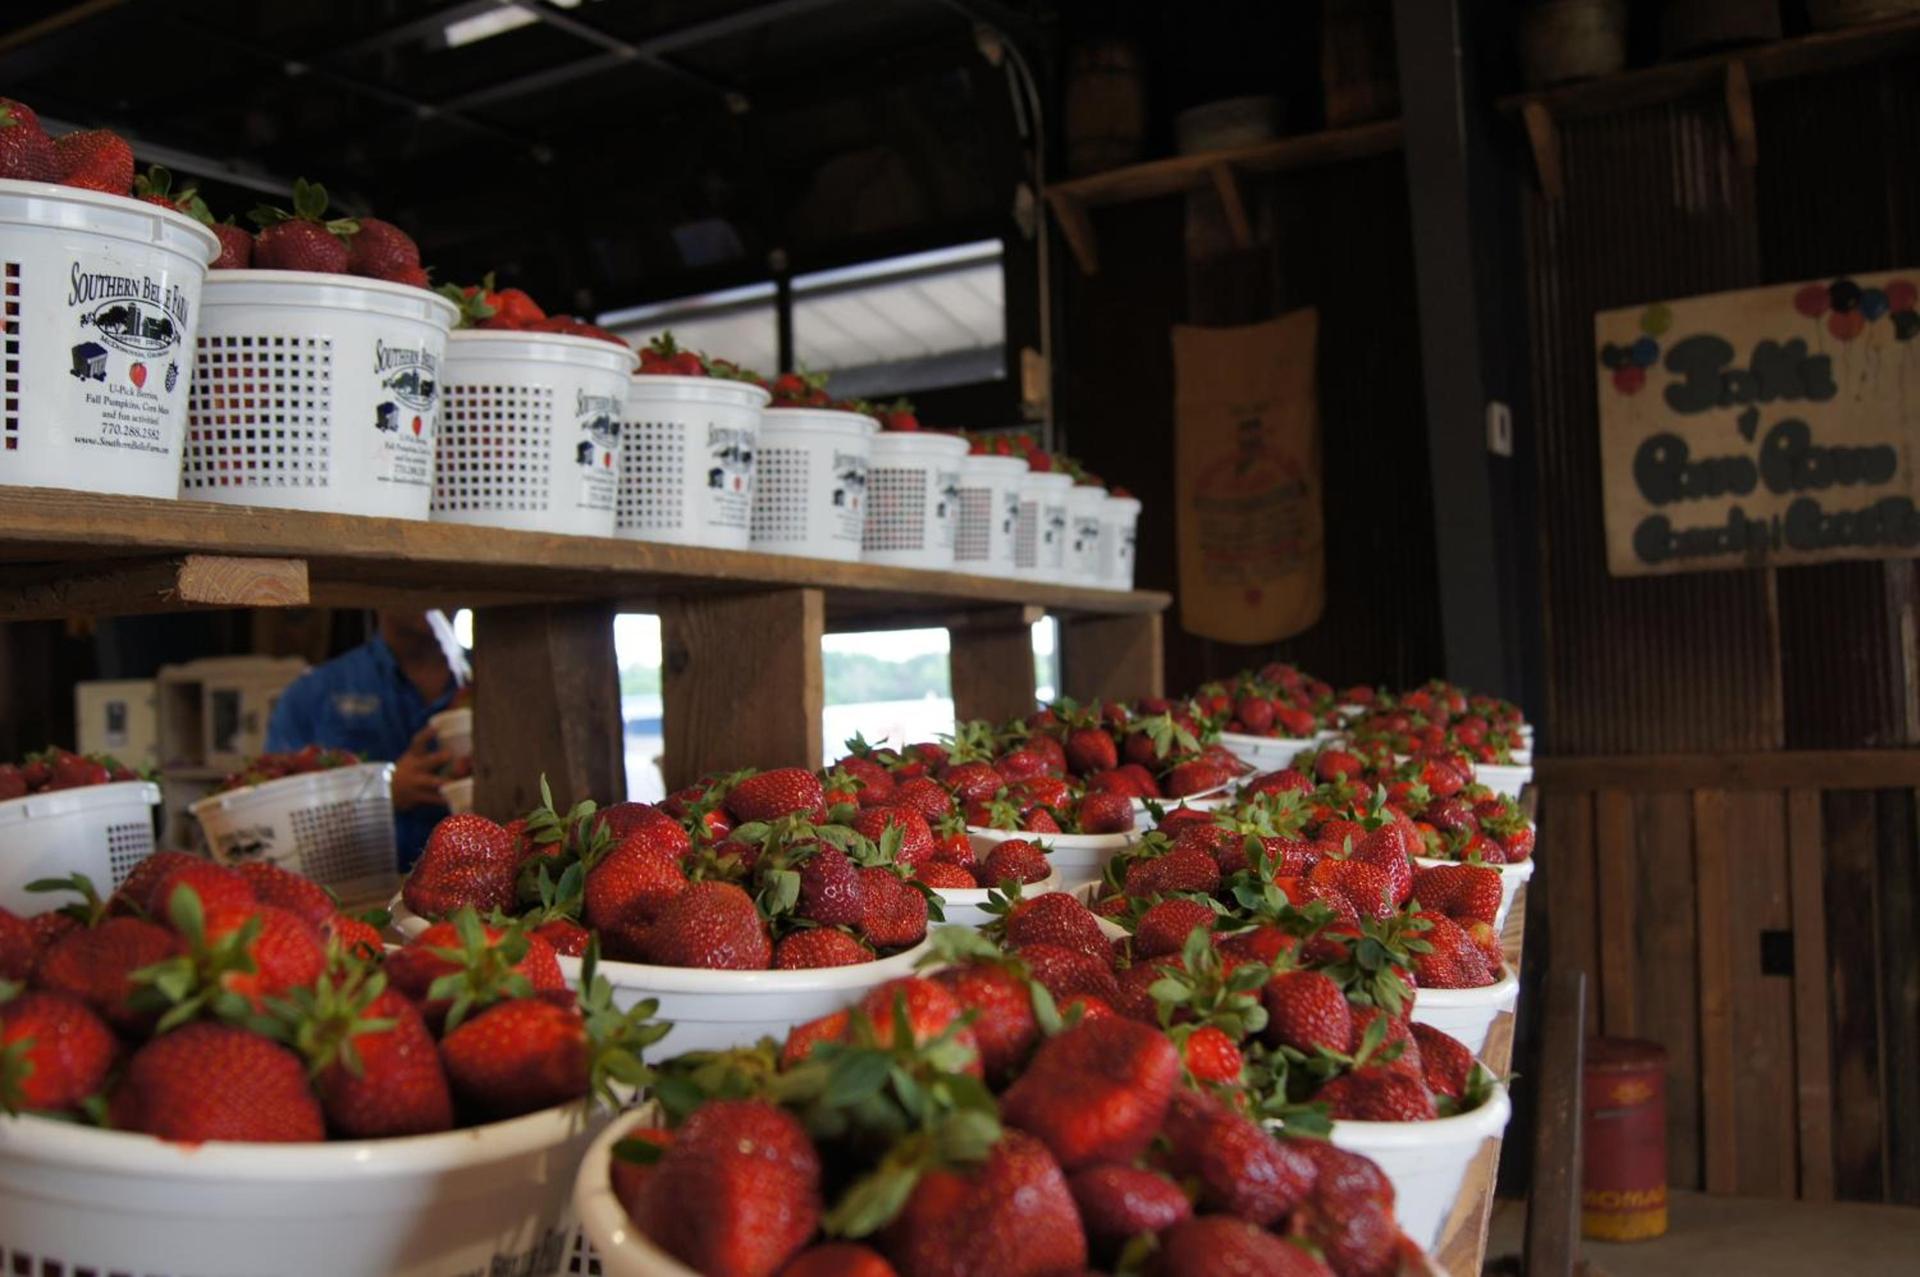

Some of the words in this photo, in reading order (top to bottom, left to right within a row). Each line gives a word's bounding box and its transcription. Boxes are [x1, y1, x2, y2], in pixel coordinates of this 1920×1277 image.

[68, 261, 140, 307] SOUTHERN
[142, 276, 171, 310] BELE
[85, 393, 101, 404] Fall
[102, 410, 116, 419] and
[118, 411, 130, 421] fun
